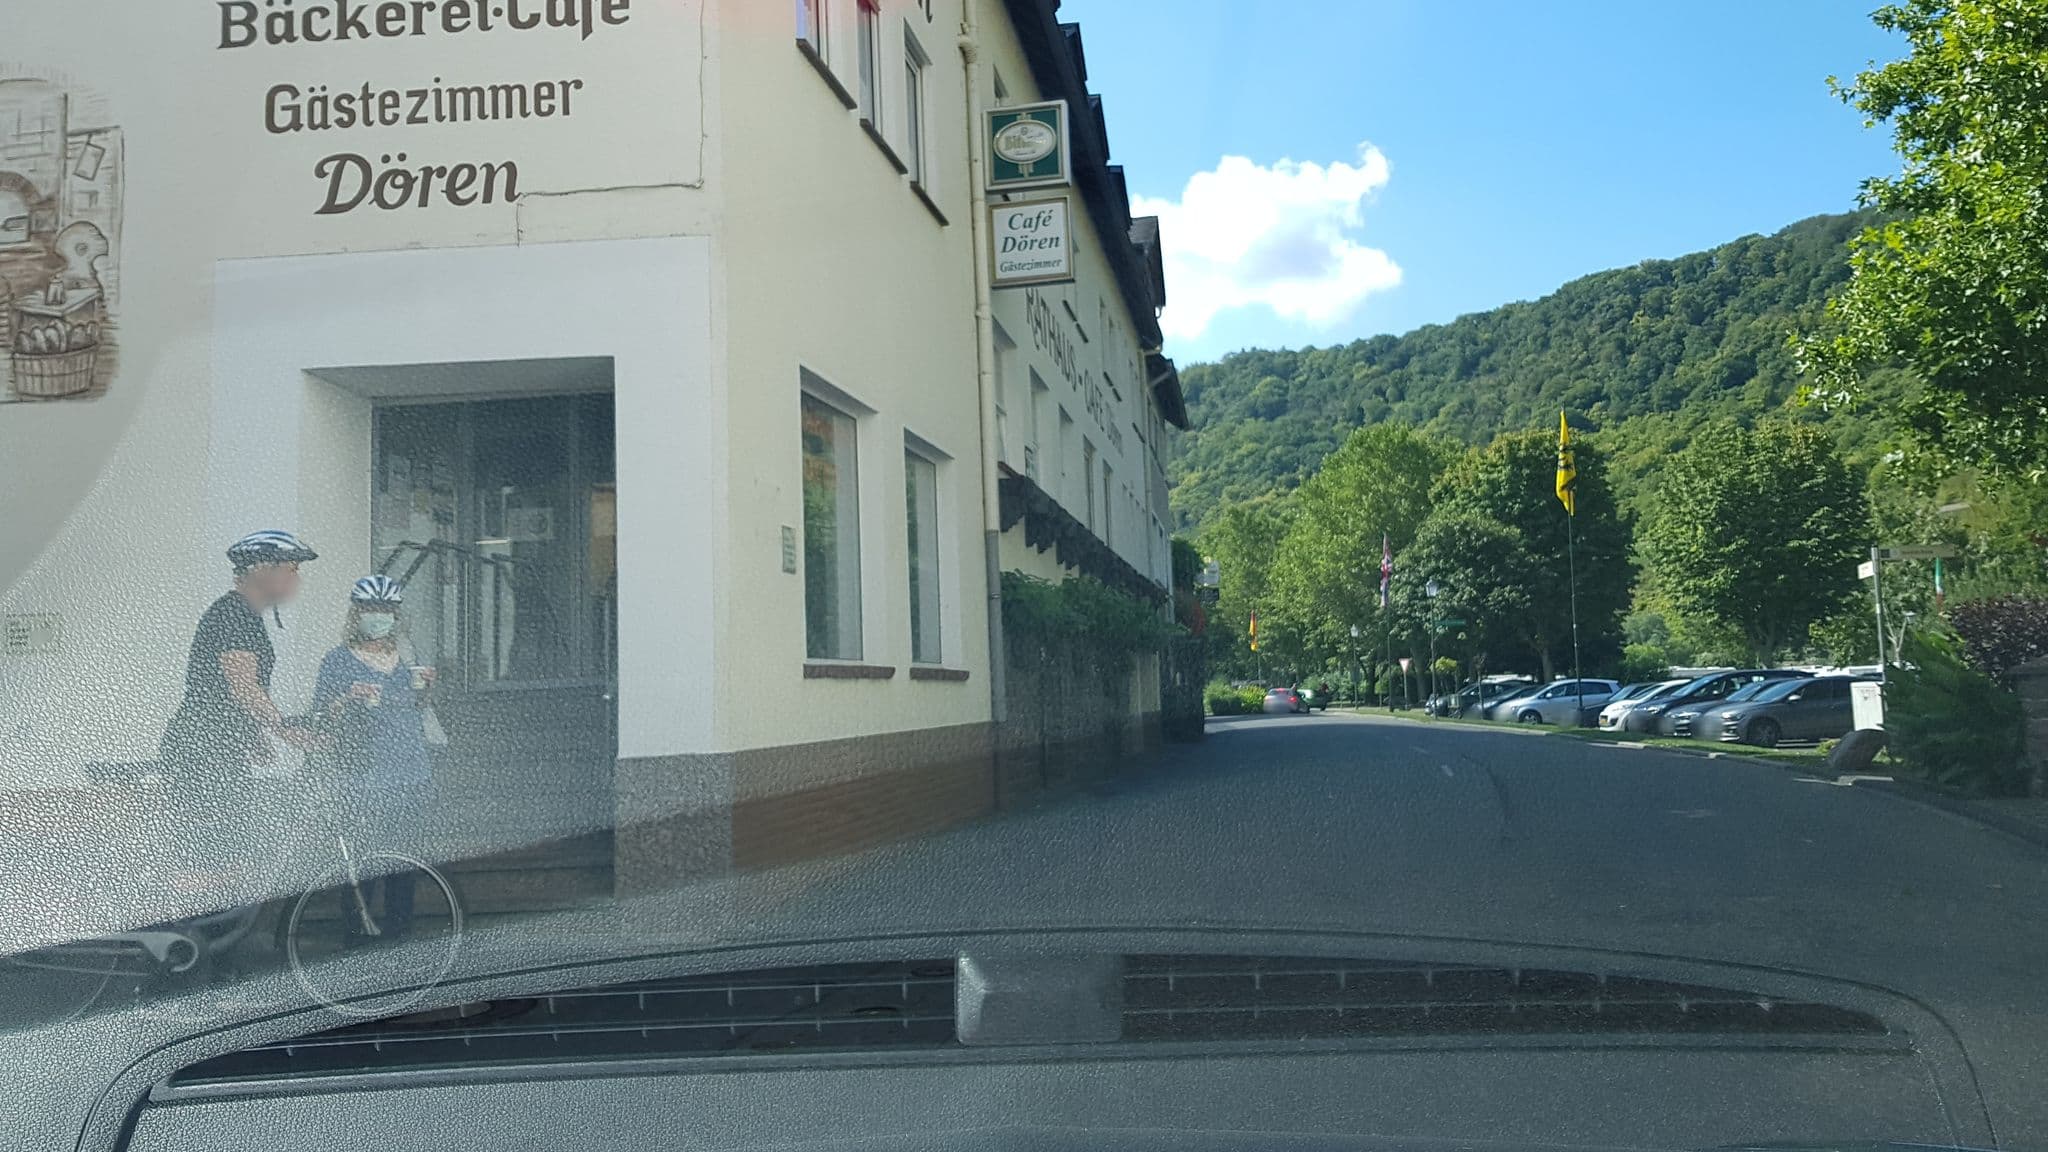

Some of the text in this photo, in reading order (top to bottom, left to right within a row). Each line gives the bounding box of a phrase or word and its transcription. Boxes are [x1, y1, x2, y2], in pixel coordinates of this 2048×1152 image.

[265, 76, 583, 134] Gästezimmer
[314, 152, 521, 215] Dören
[1008, 209, 1053, 233] Café
[1001, 234, 1060, 253] Dören
[1000, 257, 1062, 273] Gästezimmer
